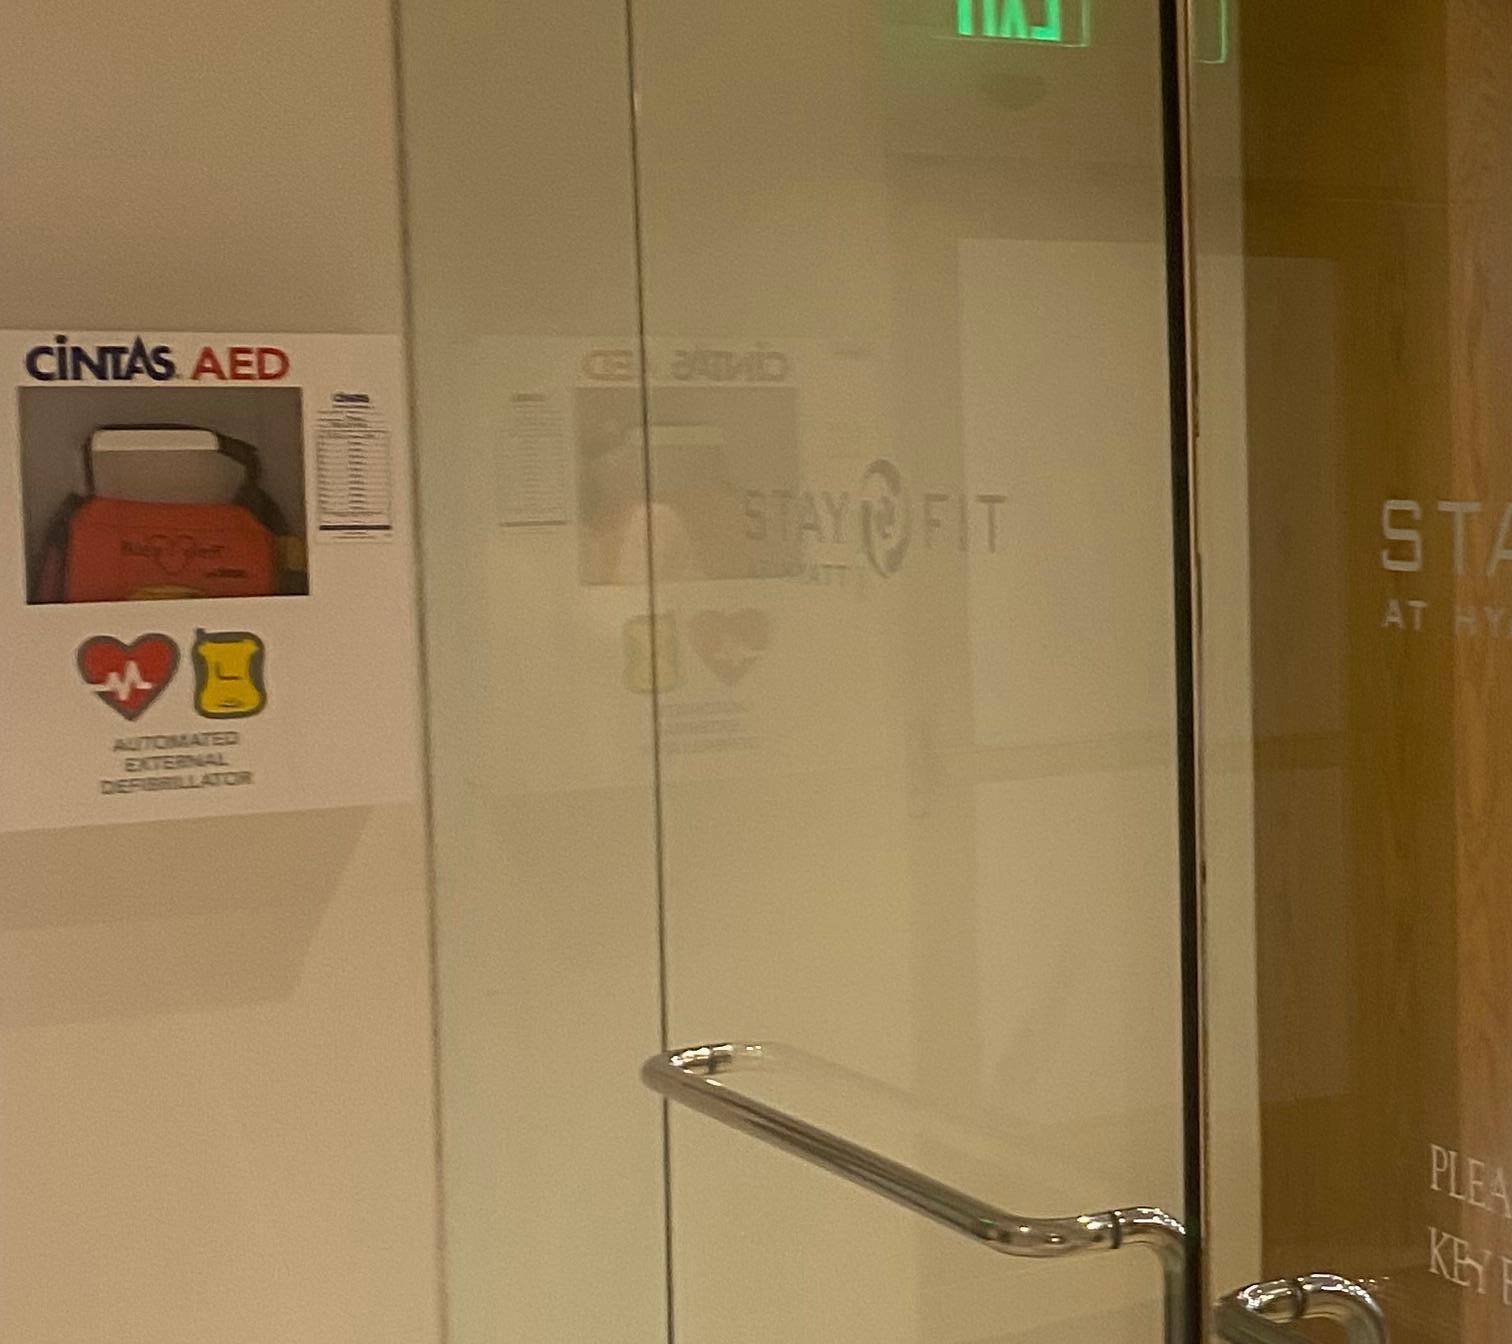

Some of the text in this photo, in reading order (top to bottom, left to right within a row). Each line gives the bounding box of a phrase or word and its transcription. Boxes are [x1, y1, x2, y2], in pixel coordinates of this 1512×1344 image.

[191, 346, 290, 381] AED
[1381, 598, 1429, 632] AT
[113, 730, 239, 752] AUTOMATED
[124, 752, 229, 773] EXTERNAL
[100, 771, 254, 795] DEFIBRILLATOR
[1427, 1226, 1490, 1298] KEY
